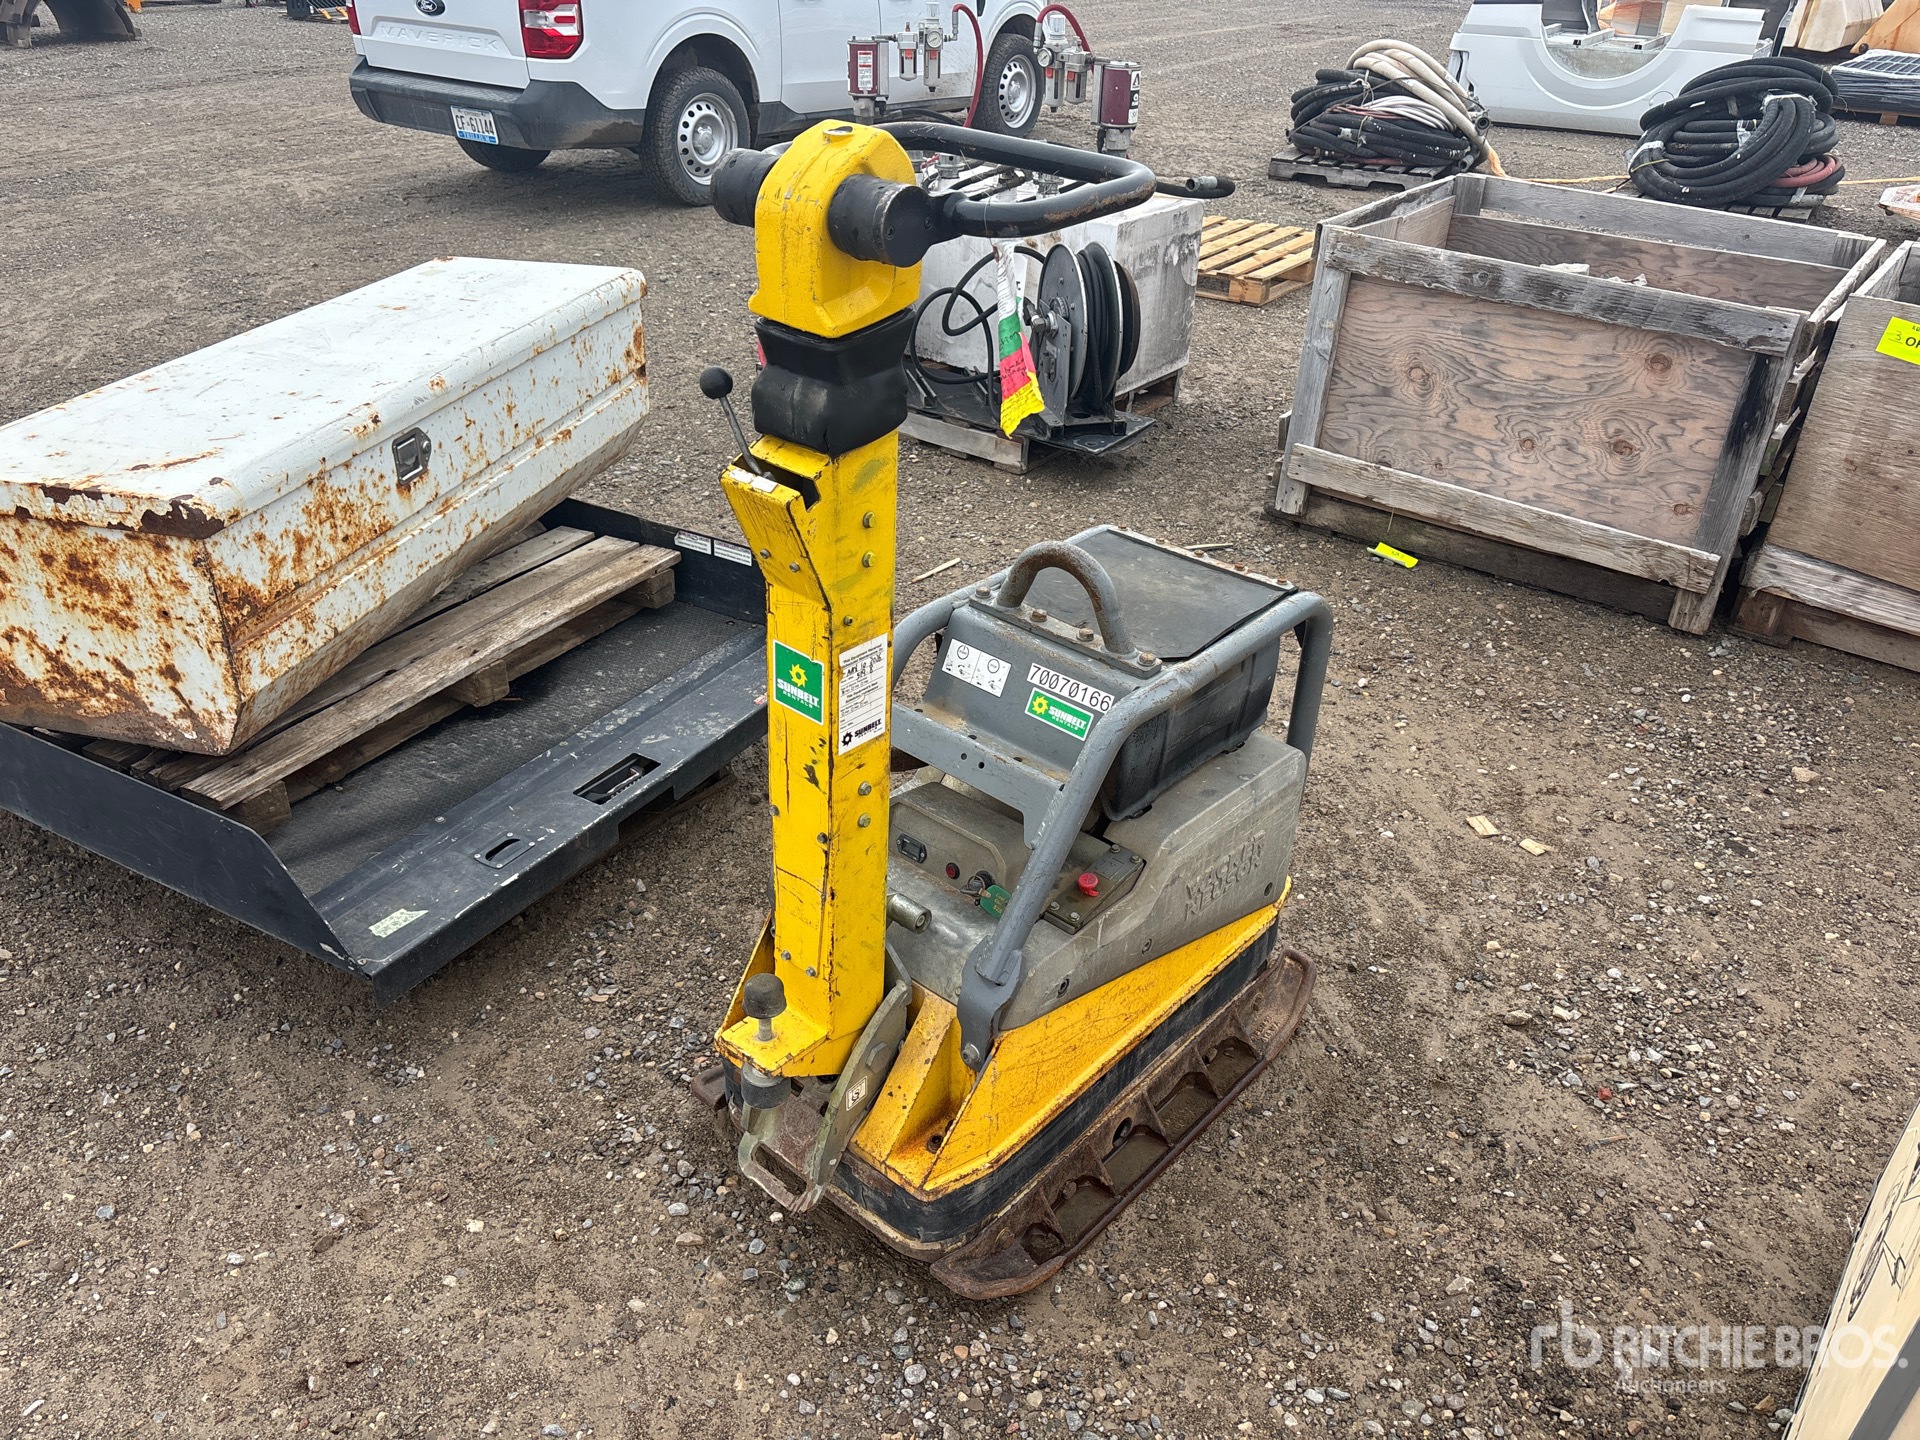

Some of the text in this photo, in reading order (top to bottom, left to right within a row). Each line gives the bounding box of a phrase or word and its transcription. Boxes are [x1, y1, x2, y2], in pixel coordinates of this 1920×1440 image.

[381, 25, 499, 52] MAVERICK
[777, 678, 820, 708] SUNBELT
[1030, 665, 1112, 712] 70070166
[854, 717, 882, 738] SUNBELT
[1048, 705, 1087, 730] SUNBELT
[1051, 715, 1079, 731] RENTALS
